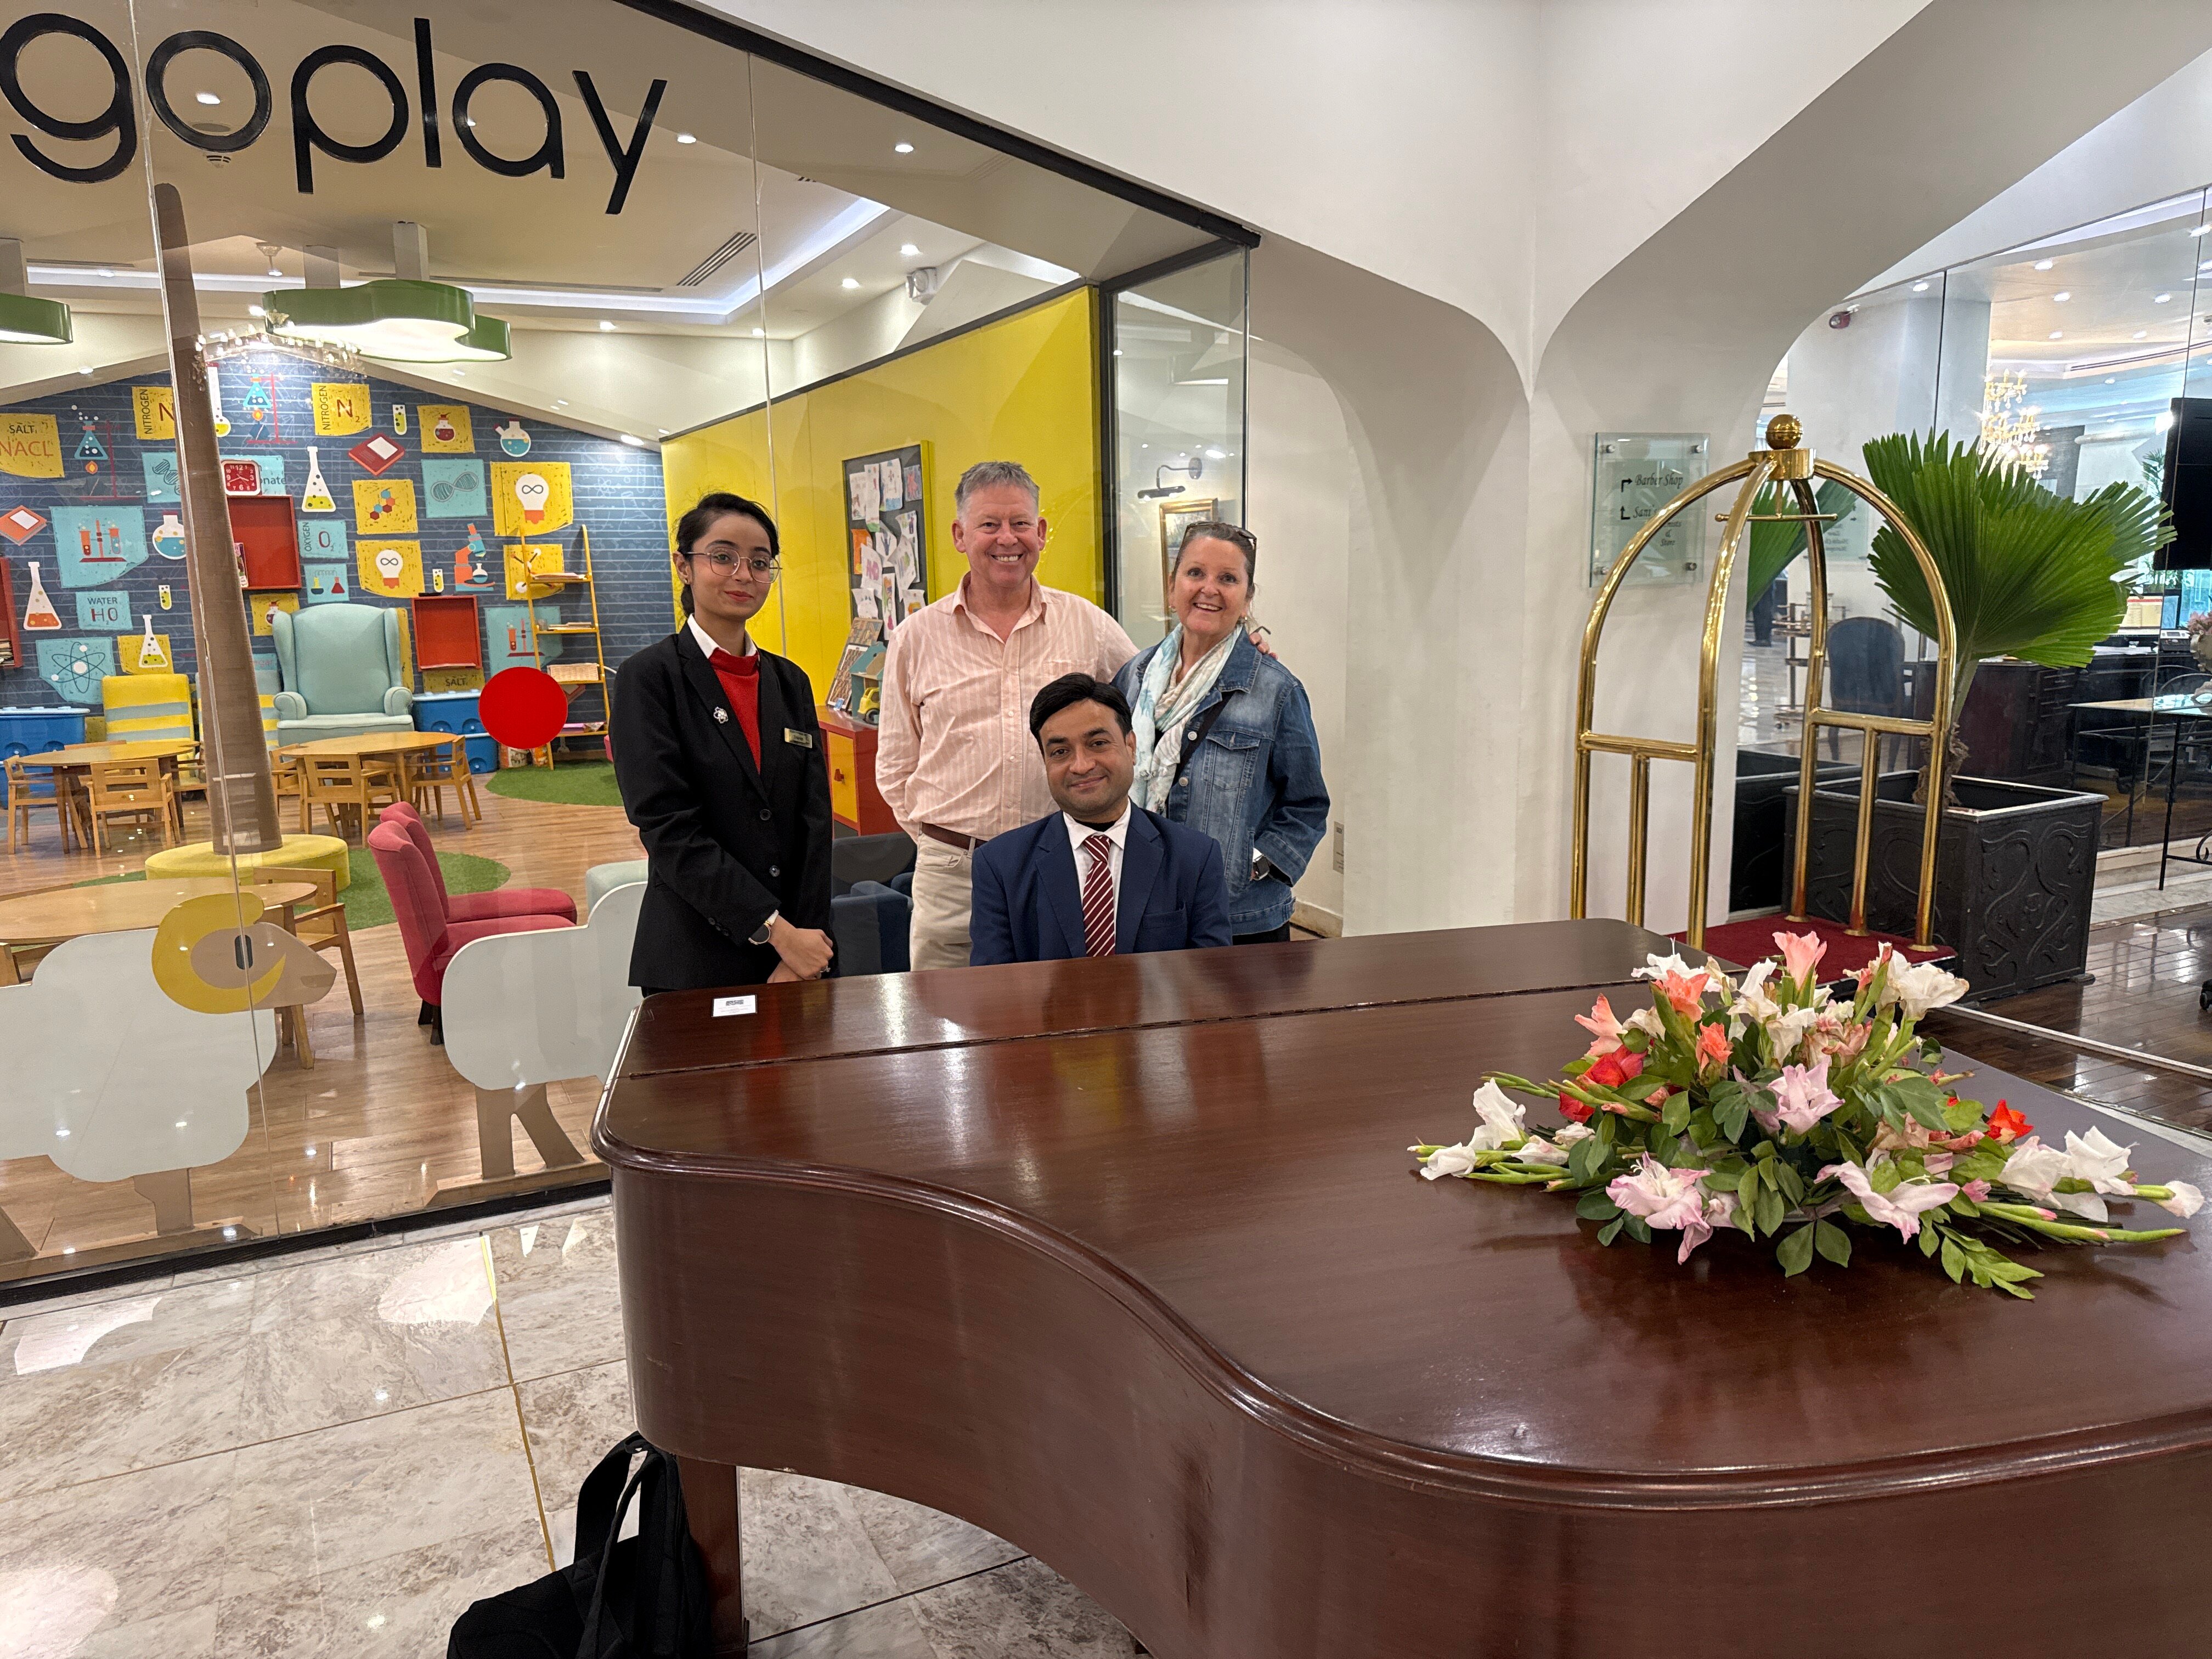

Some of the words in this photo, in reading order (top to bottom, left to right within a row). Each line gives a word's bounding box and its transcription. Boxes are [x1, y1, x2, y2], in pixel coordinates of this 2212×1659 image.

[0, 13, 667, 215] goplay
[139, 388, 153, 435] NITROGEN
[318, 385, 331, 430] NITROGEN
[9, 425, 35, 434] SALT
[1635, 472, 1663, 486] Barber
[1663, 472, 1683, 489] Shop
[302, 522, 312, 552] OXYGEN
[87, 597, 118, 605] WATER
[445, 678, 467, 686] SALT
